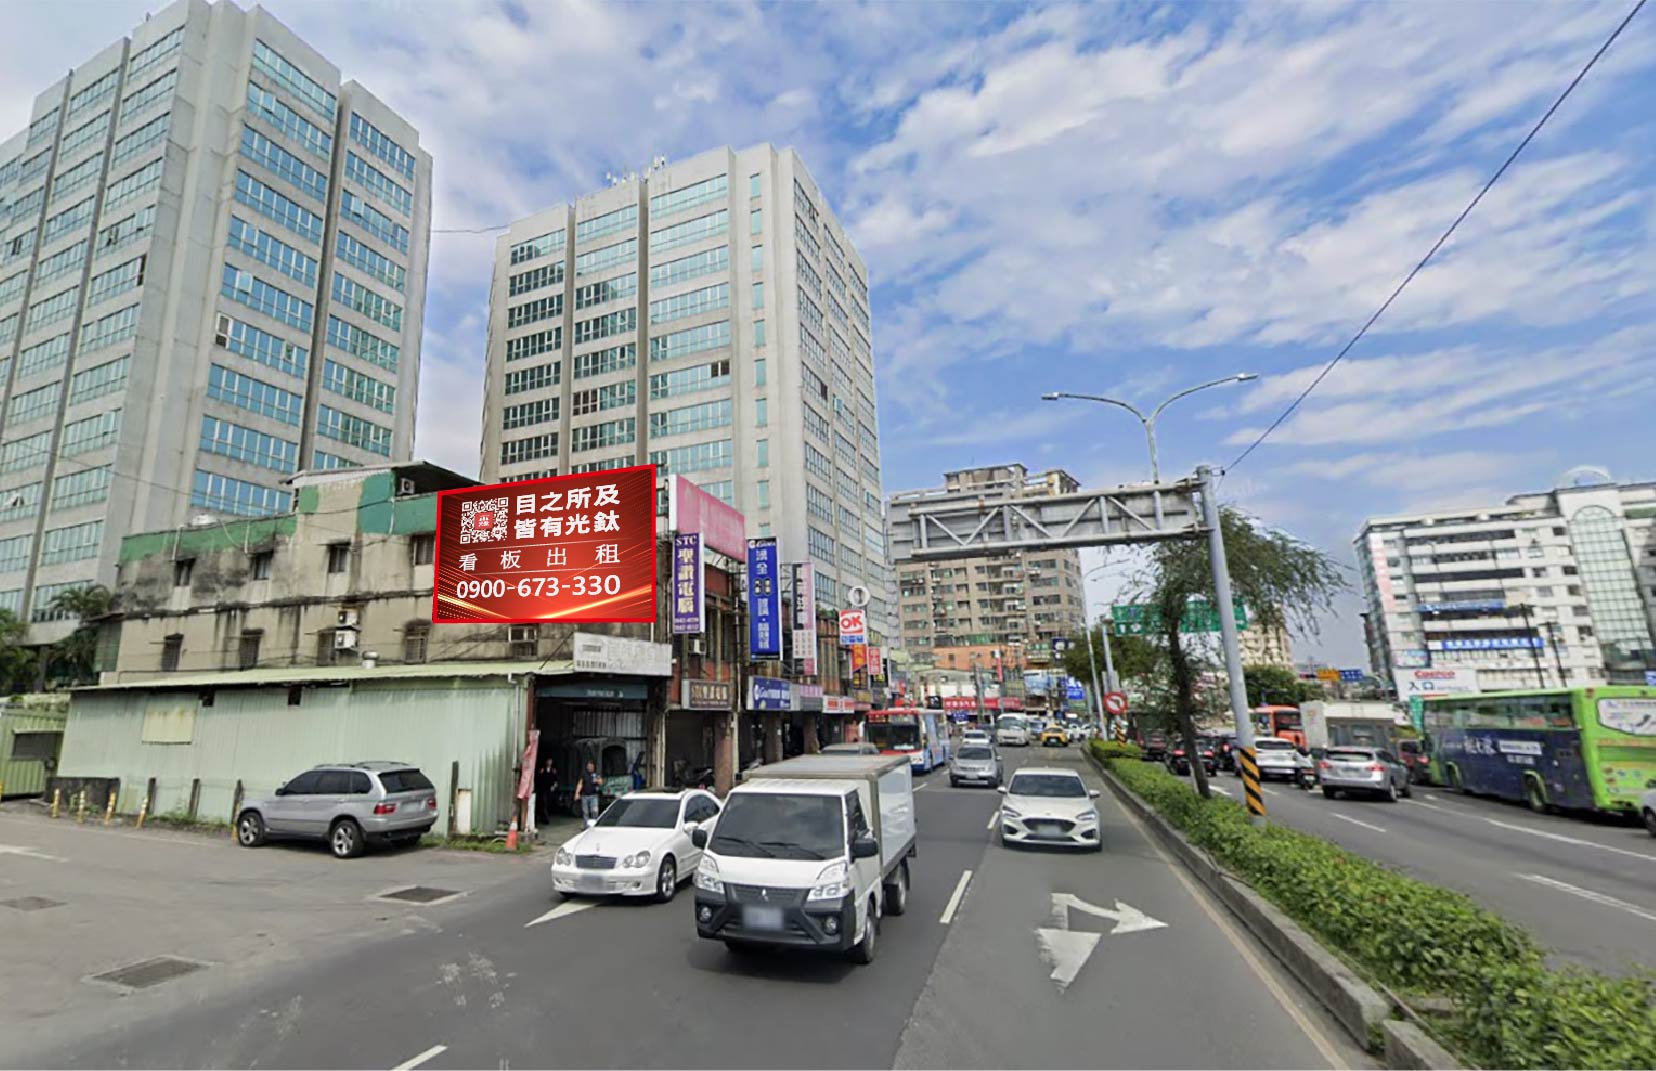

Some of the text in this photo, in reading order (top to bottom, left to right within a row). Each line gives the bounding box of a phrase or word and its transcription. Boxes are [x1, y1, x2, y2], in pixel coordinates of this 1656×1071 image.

[516, 483, 621, 515] 目之所及
[514, 510, 621, 540] 皆有光鈦
[676, 535, 697, 546] STC
[458, 543, 621, 572] 看板出租
[456, 574, 621, 599] 0900-673-330
[841, 615, 863, 630] OK
[1409, 681, 1435, 691] 入口
